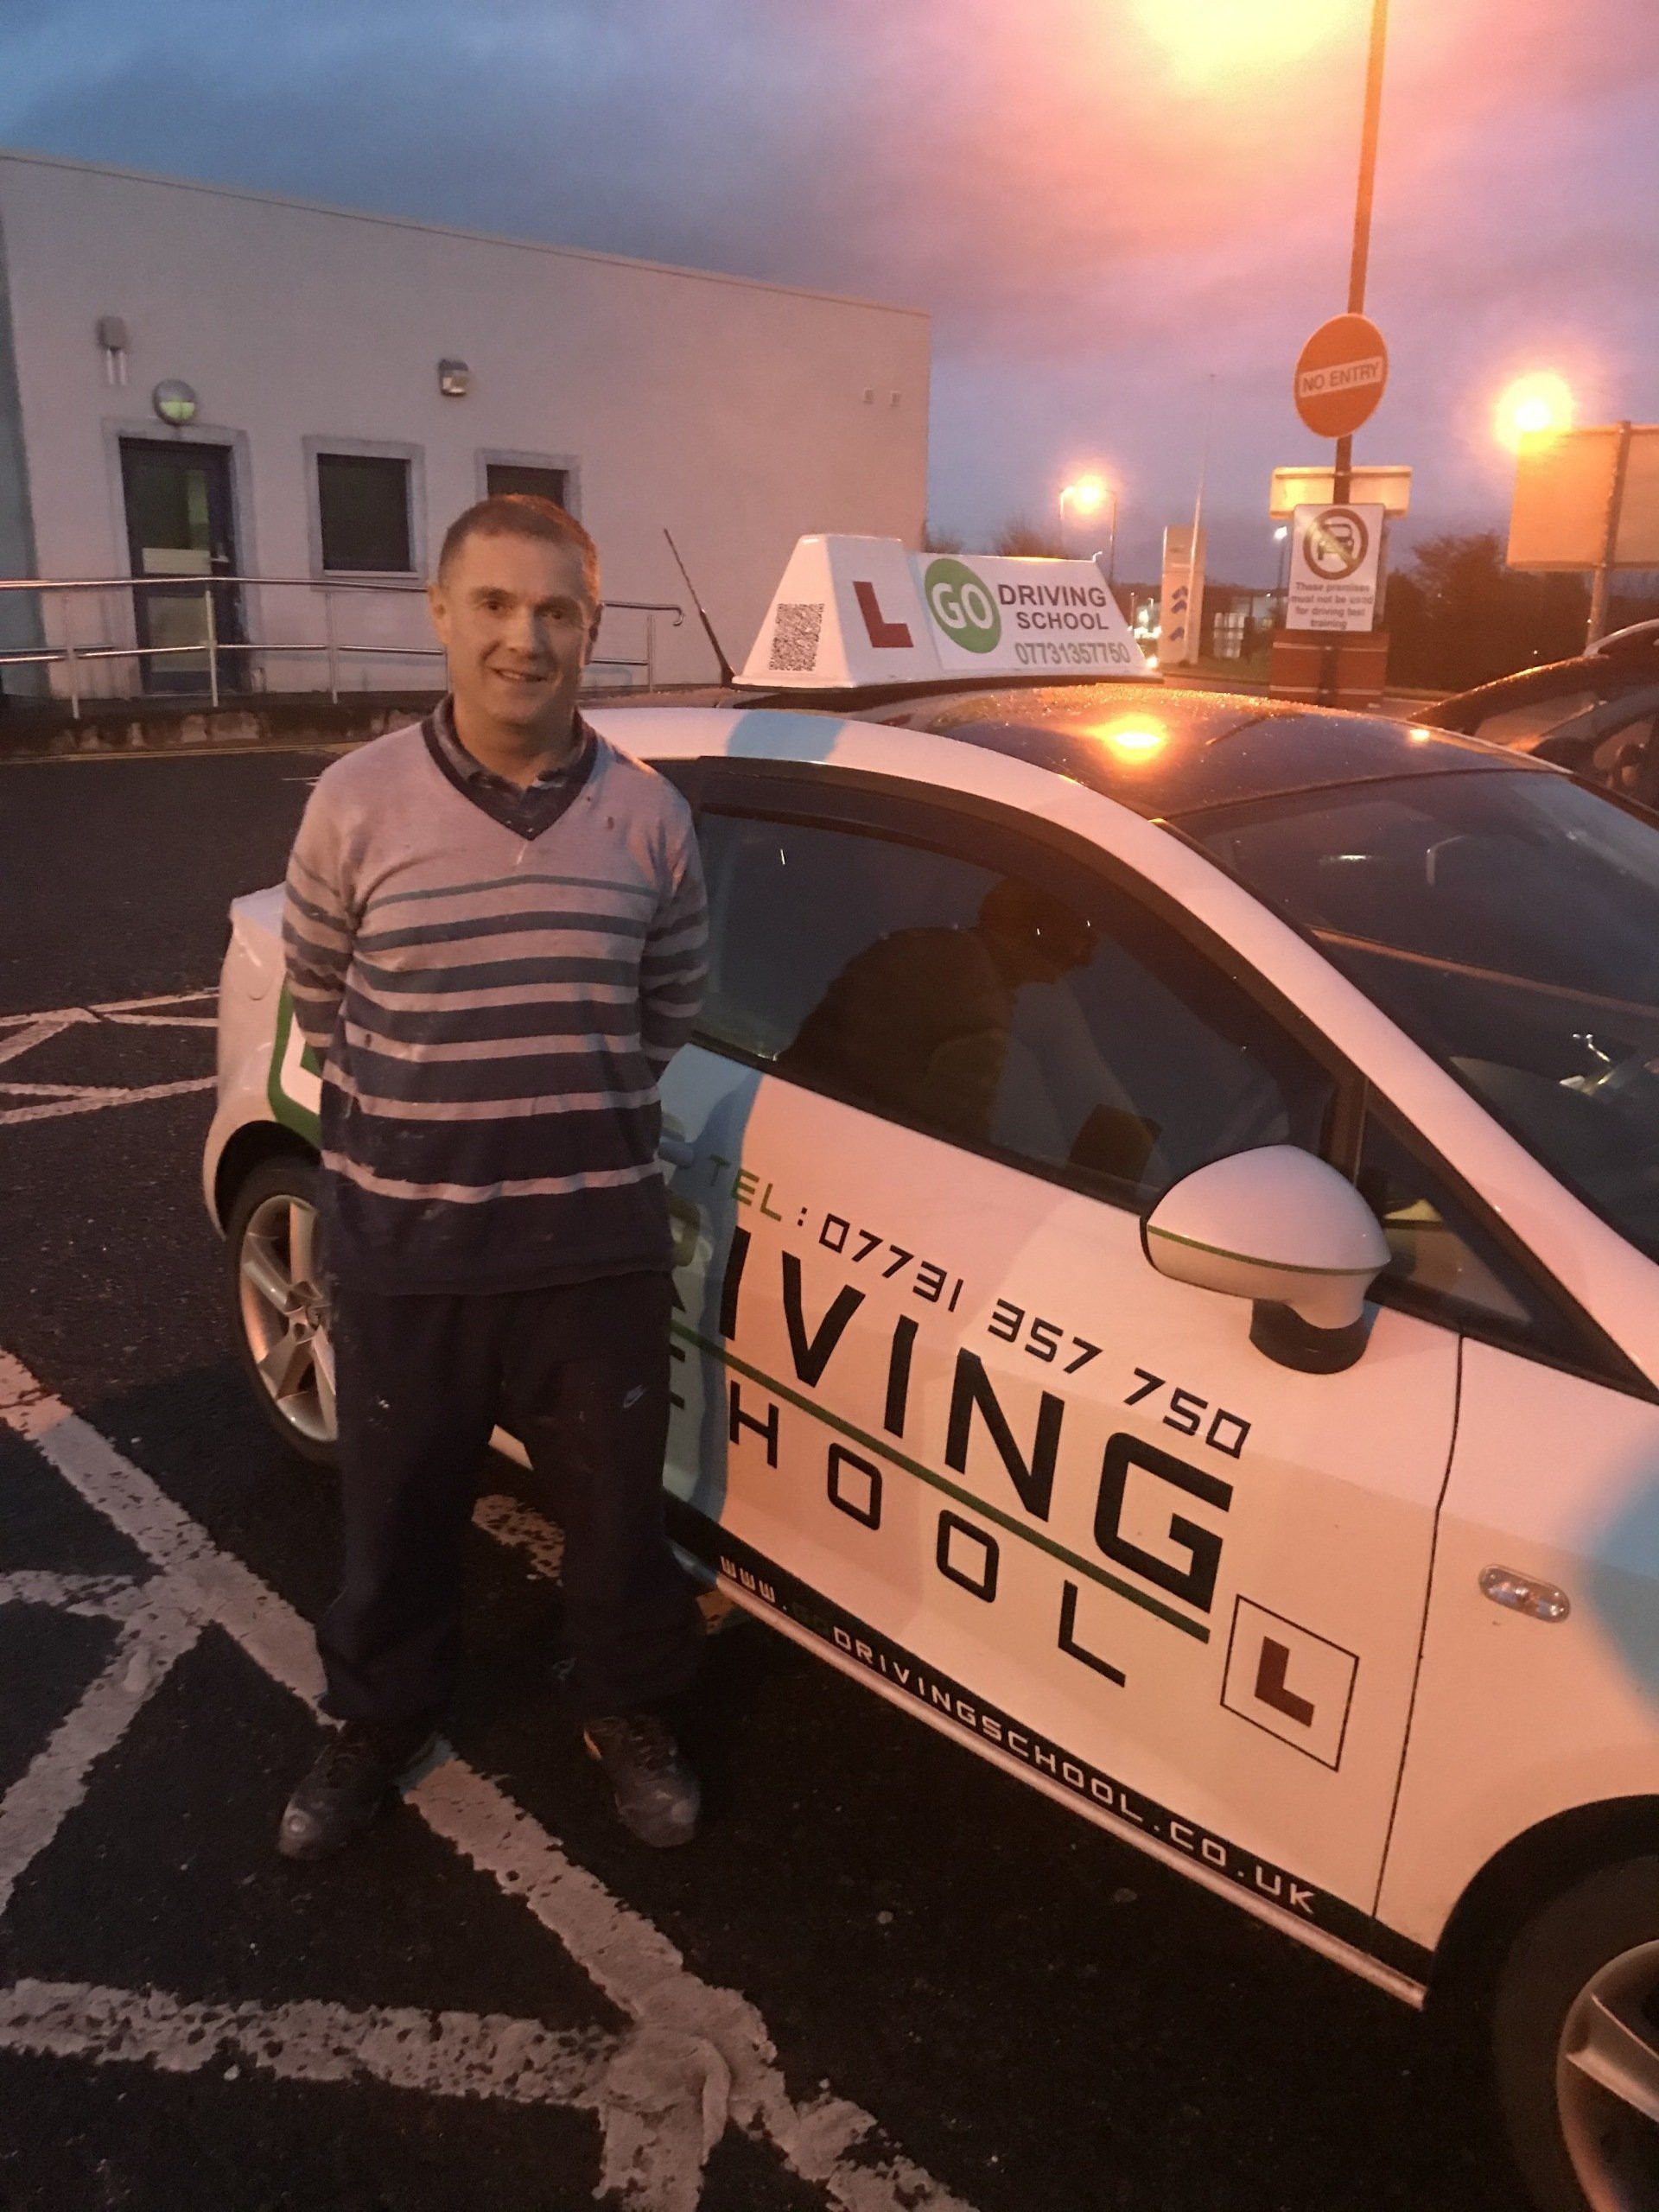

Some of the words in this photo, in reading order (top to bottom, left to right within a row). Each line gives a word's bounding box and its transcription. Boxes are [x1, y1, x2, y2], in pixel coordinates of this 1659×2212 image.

[1301, 374, 1325, 393] NO
[1329, 361, 1380, 387] ENTRY
[853, 581, 913, 648] L
[931, 582, 994, 630] GO
[998, 583, 1106, 607] DRIVING
[1016, 611, 1109, 631] SCHOOL
[1014, 642, 1131, 665] 07731357750
[988, 1298, 1103, 1374] 357
[1122, 1367, 1251, 1459] 750
[672, 1225, 1234, 1613] IVING
[670, 1344, 1126, 1688] HOOL
[1255, 1635, 1315, 1727] L
